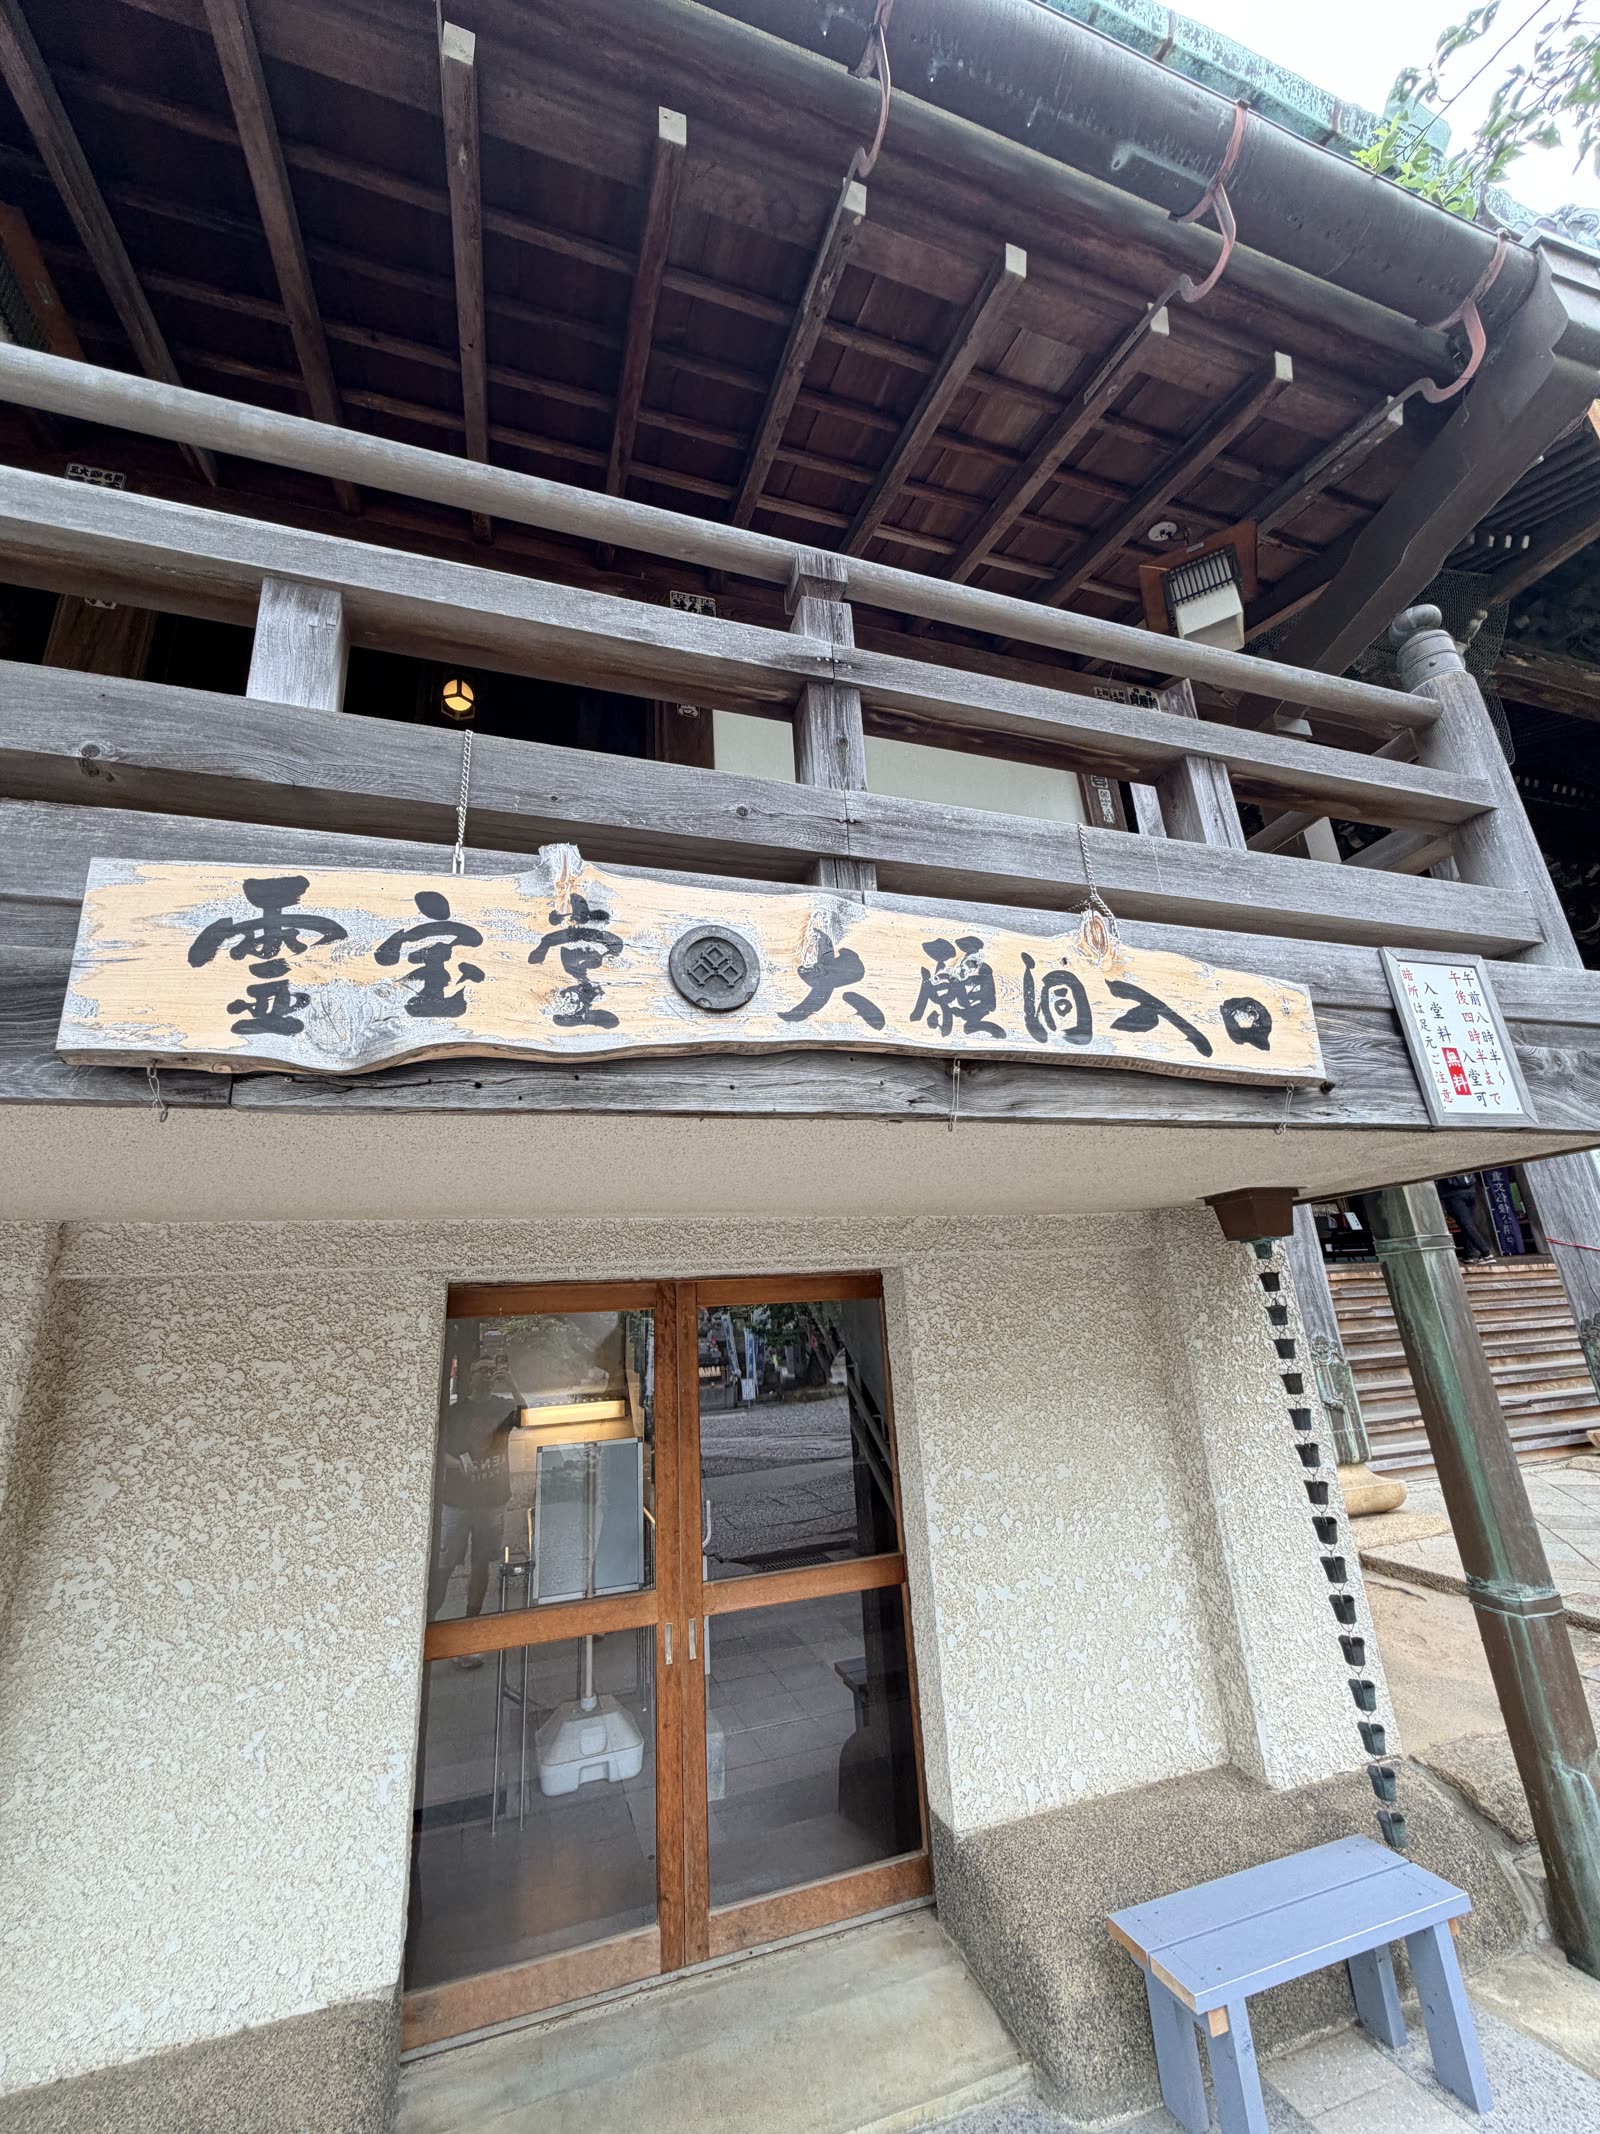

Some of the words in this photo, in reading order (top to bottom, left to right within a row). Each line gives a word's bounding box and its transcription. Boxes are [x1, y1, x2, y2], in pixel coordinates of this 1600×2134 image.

[1424, 982, 1452, 1044] 入堂料
[1444, 1050, 1469, 1093] 無料
[1449, 971, 1501, 1106] 午後四時半まで
[1462, 1050, 1488, 1108] 入堂可
